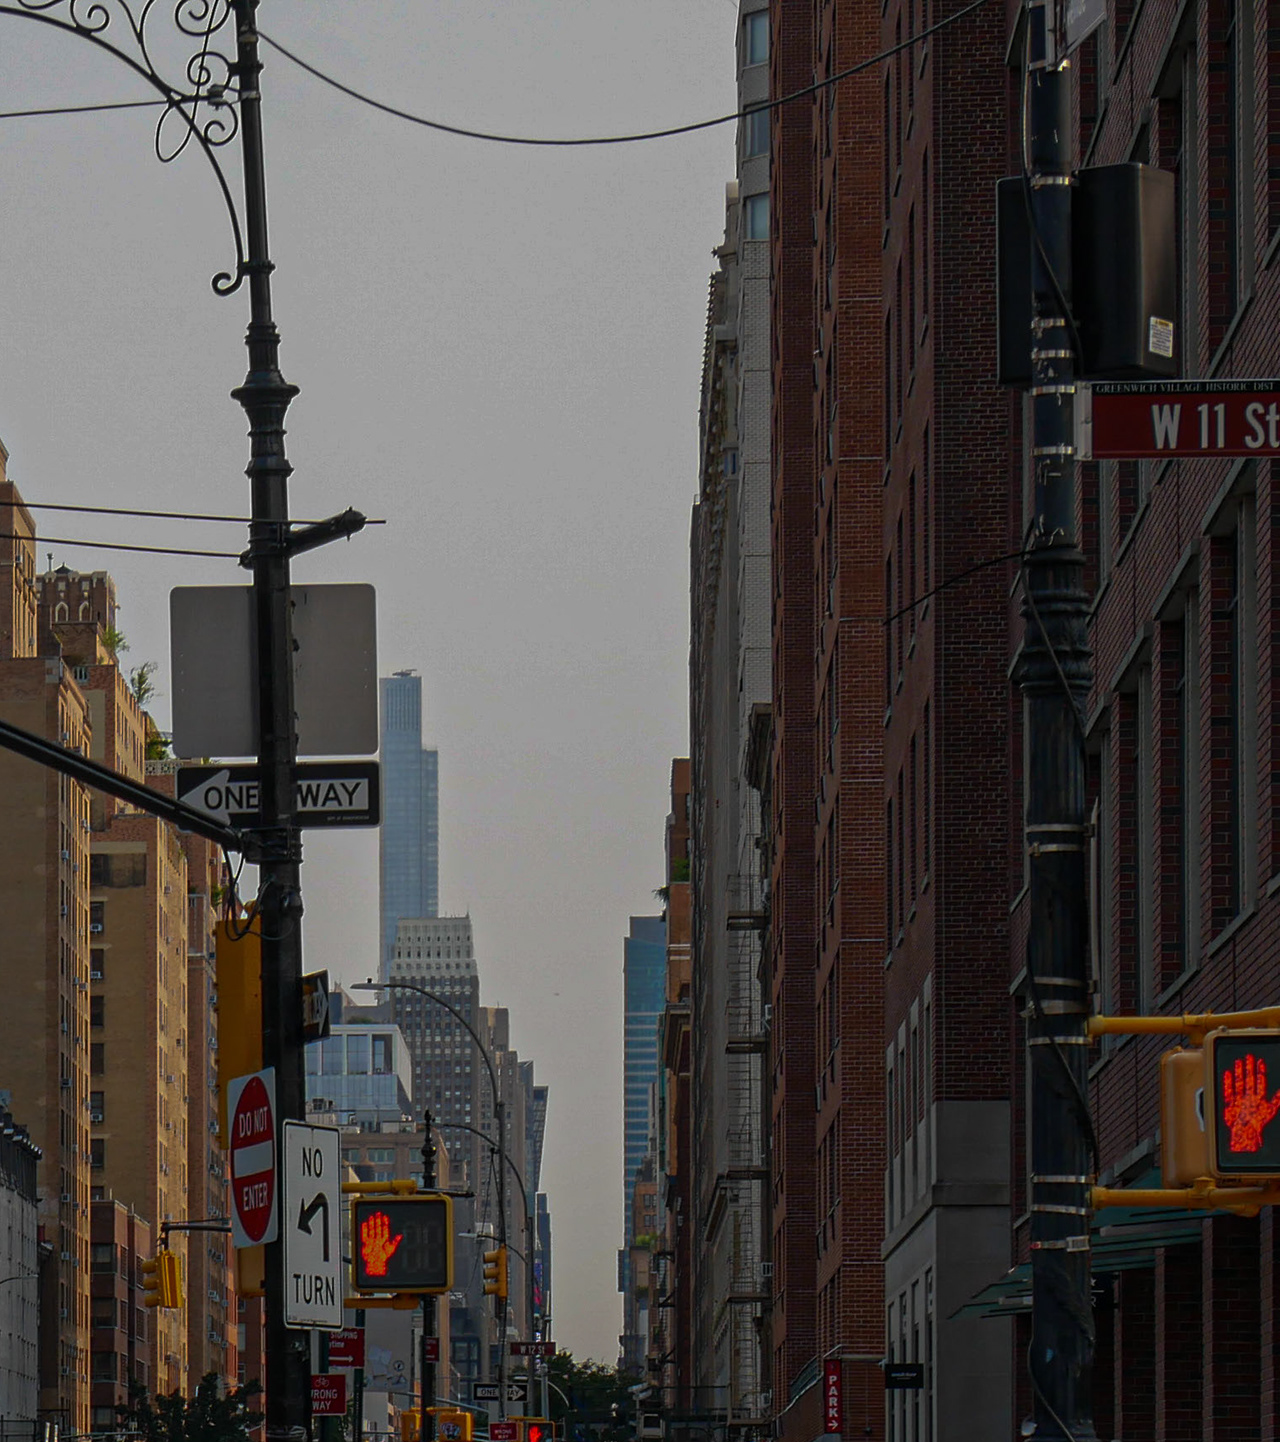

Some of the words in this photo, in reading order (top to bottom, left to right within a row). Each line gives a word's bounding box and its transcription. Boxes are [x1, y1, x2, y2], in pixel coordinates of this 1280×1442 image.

[1096, 384, 1157, 394] GREENWICH
[1161, 383, 1201, 393] VILLAGE
[1206, 382, 1249, 392] HISTORIC
[1254, 381, 1275, 391] DIST
[1151, 403, 1182, 450] W
[1197, 402, 1226, 449] 11
[1244, 401, 1280, 449] St
[204, 785, 259, 810] ONE
[298, 781, 362, 808] WAY
[239, 1113, 252, 1138] DO
[253, 1106, 268, 1134] NOT
[302, 1147, 323, 1178] NO
[243, 1183, 268, 1211] ENTER
[293, 1273, 335, 1306] TURN
[330, 1331, 358, 1340] STOPPING
[520, 1345, 526, 1354] W
[528, 1345, 536, 1354] 12
[312, 1401, 332, 1411] WAY
[480, 1388, 497, 1396] ONE
[828, 1375, 839, 1418] PARK
